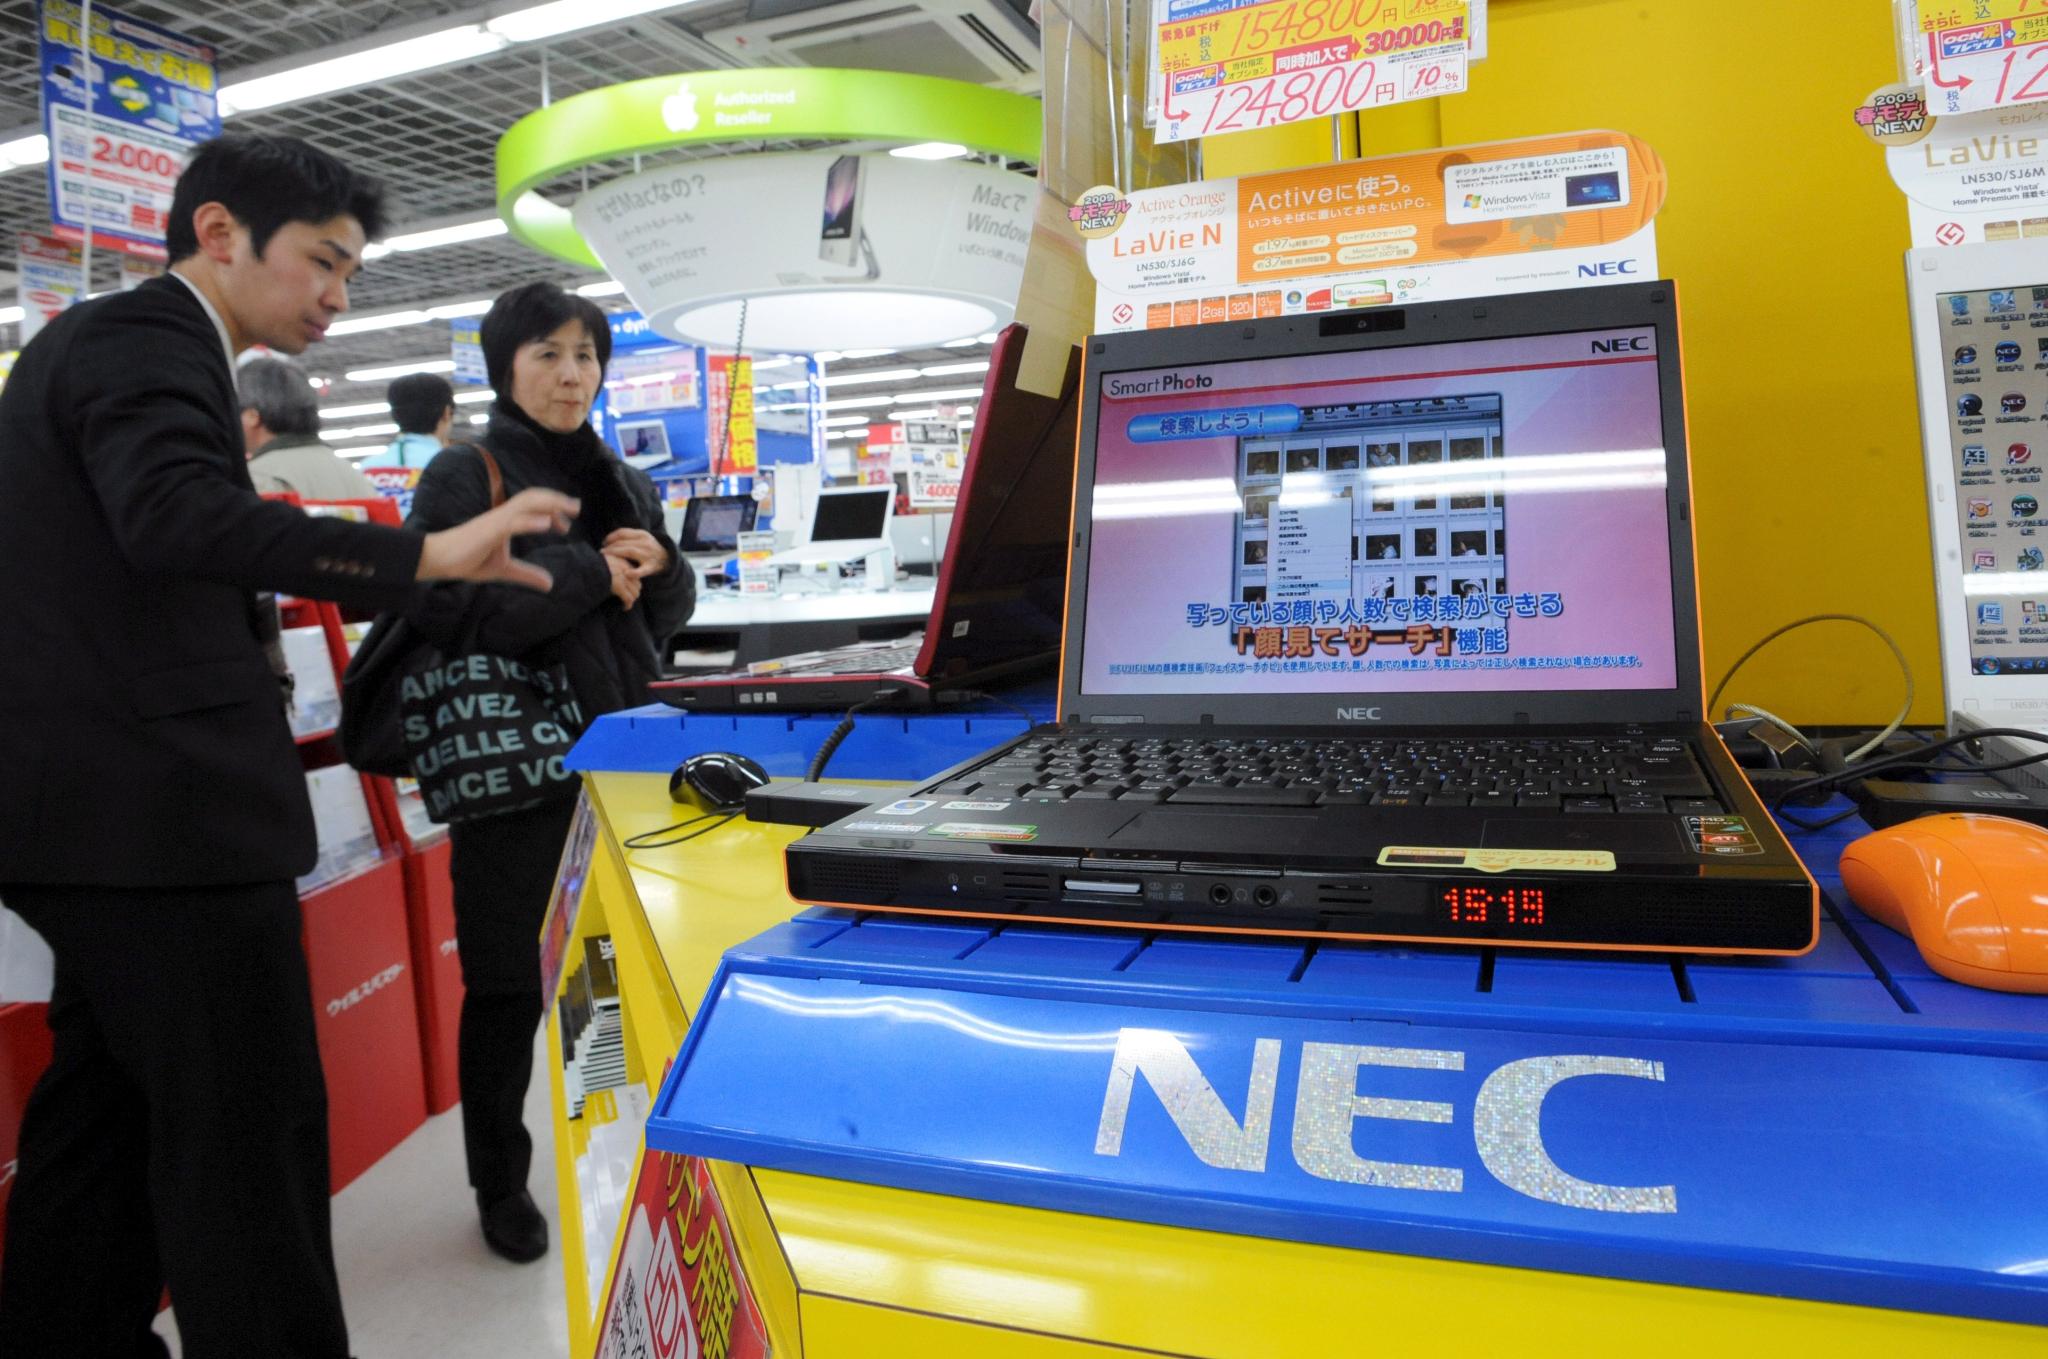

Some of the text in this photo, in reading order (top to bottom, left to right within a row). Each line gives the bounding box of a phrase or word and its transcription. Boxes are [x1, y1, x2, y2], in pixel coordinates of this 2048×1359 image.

[2024, 16, 2048, 29] 当社
[1276, 43, 1348, 71] 同時加入で
[1875, 92, 1918, 106] 2009
[715, 110, 773, 127] Reseller
[1874, 117, 1925, 137] NEW
[1996, 112, 2048, 126] モカレイ
[1924, 135, 2038, 169] LaVie
[1961, 167, 2046, 185] LN530/SJ6M
[1084, 192, 1115, 204] 2009
[1248, 174, 1411, 213] Activeに使う。
[1483, 193, 1528, 207] Windows
[1953, 197, 1978, 206] Home
[1981, 193, 2020, 203] Premium
[1973, 186, 2012, 196] Windows
[1138, 191, 1226, 214] Active Orange
[1080, 215, 1117, 231] NEW
[1113, 222, 1222, 258] LaVie N
[1136, 257, 1196, 273] LN530/SJ6G
[1577, 258, 1638, 279] NEC
[1591, 336, 1649, 354] NEC
[1160, 412, 1264, 436] 検索しよう！
[1186, 592, 1564, 628] 写っている顔や人数で検索ができる
[436, 692, 523, 729] AVEZ
[1337, 707, 1382, 721] NEC
[1094, 1027, 1677, 1213] NEC
